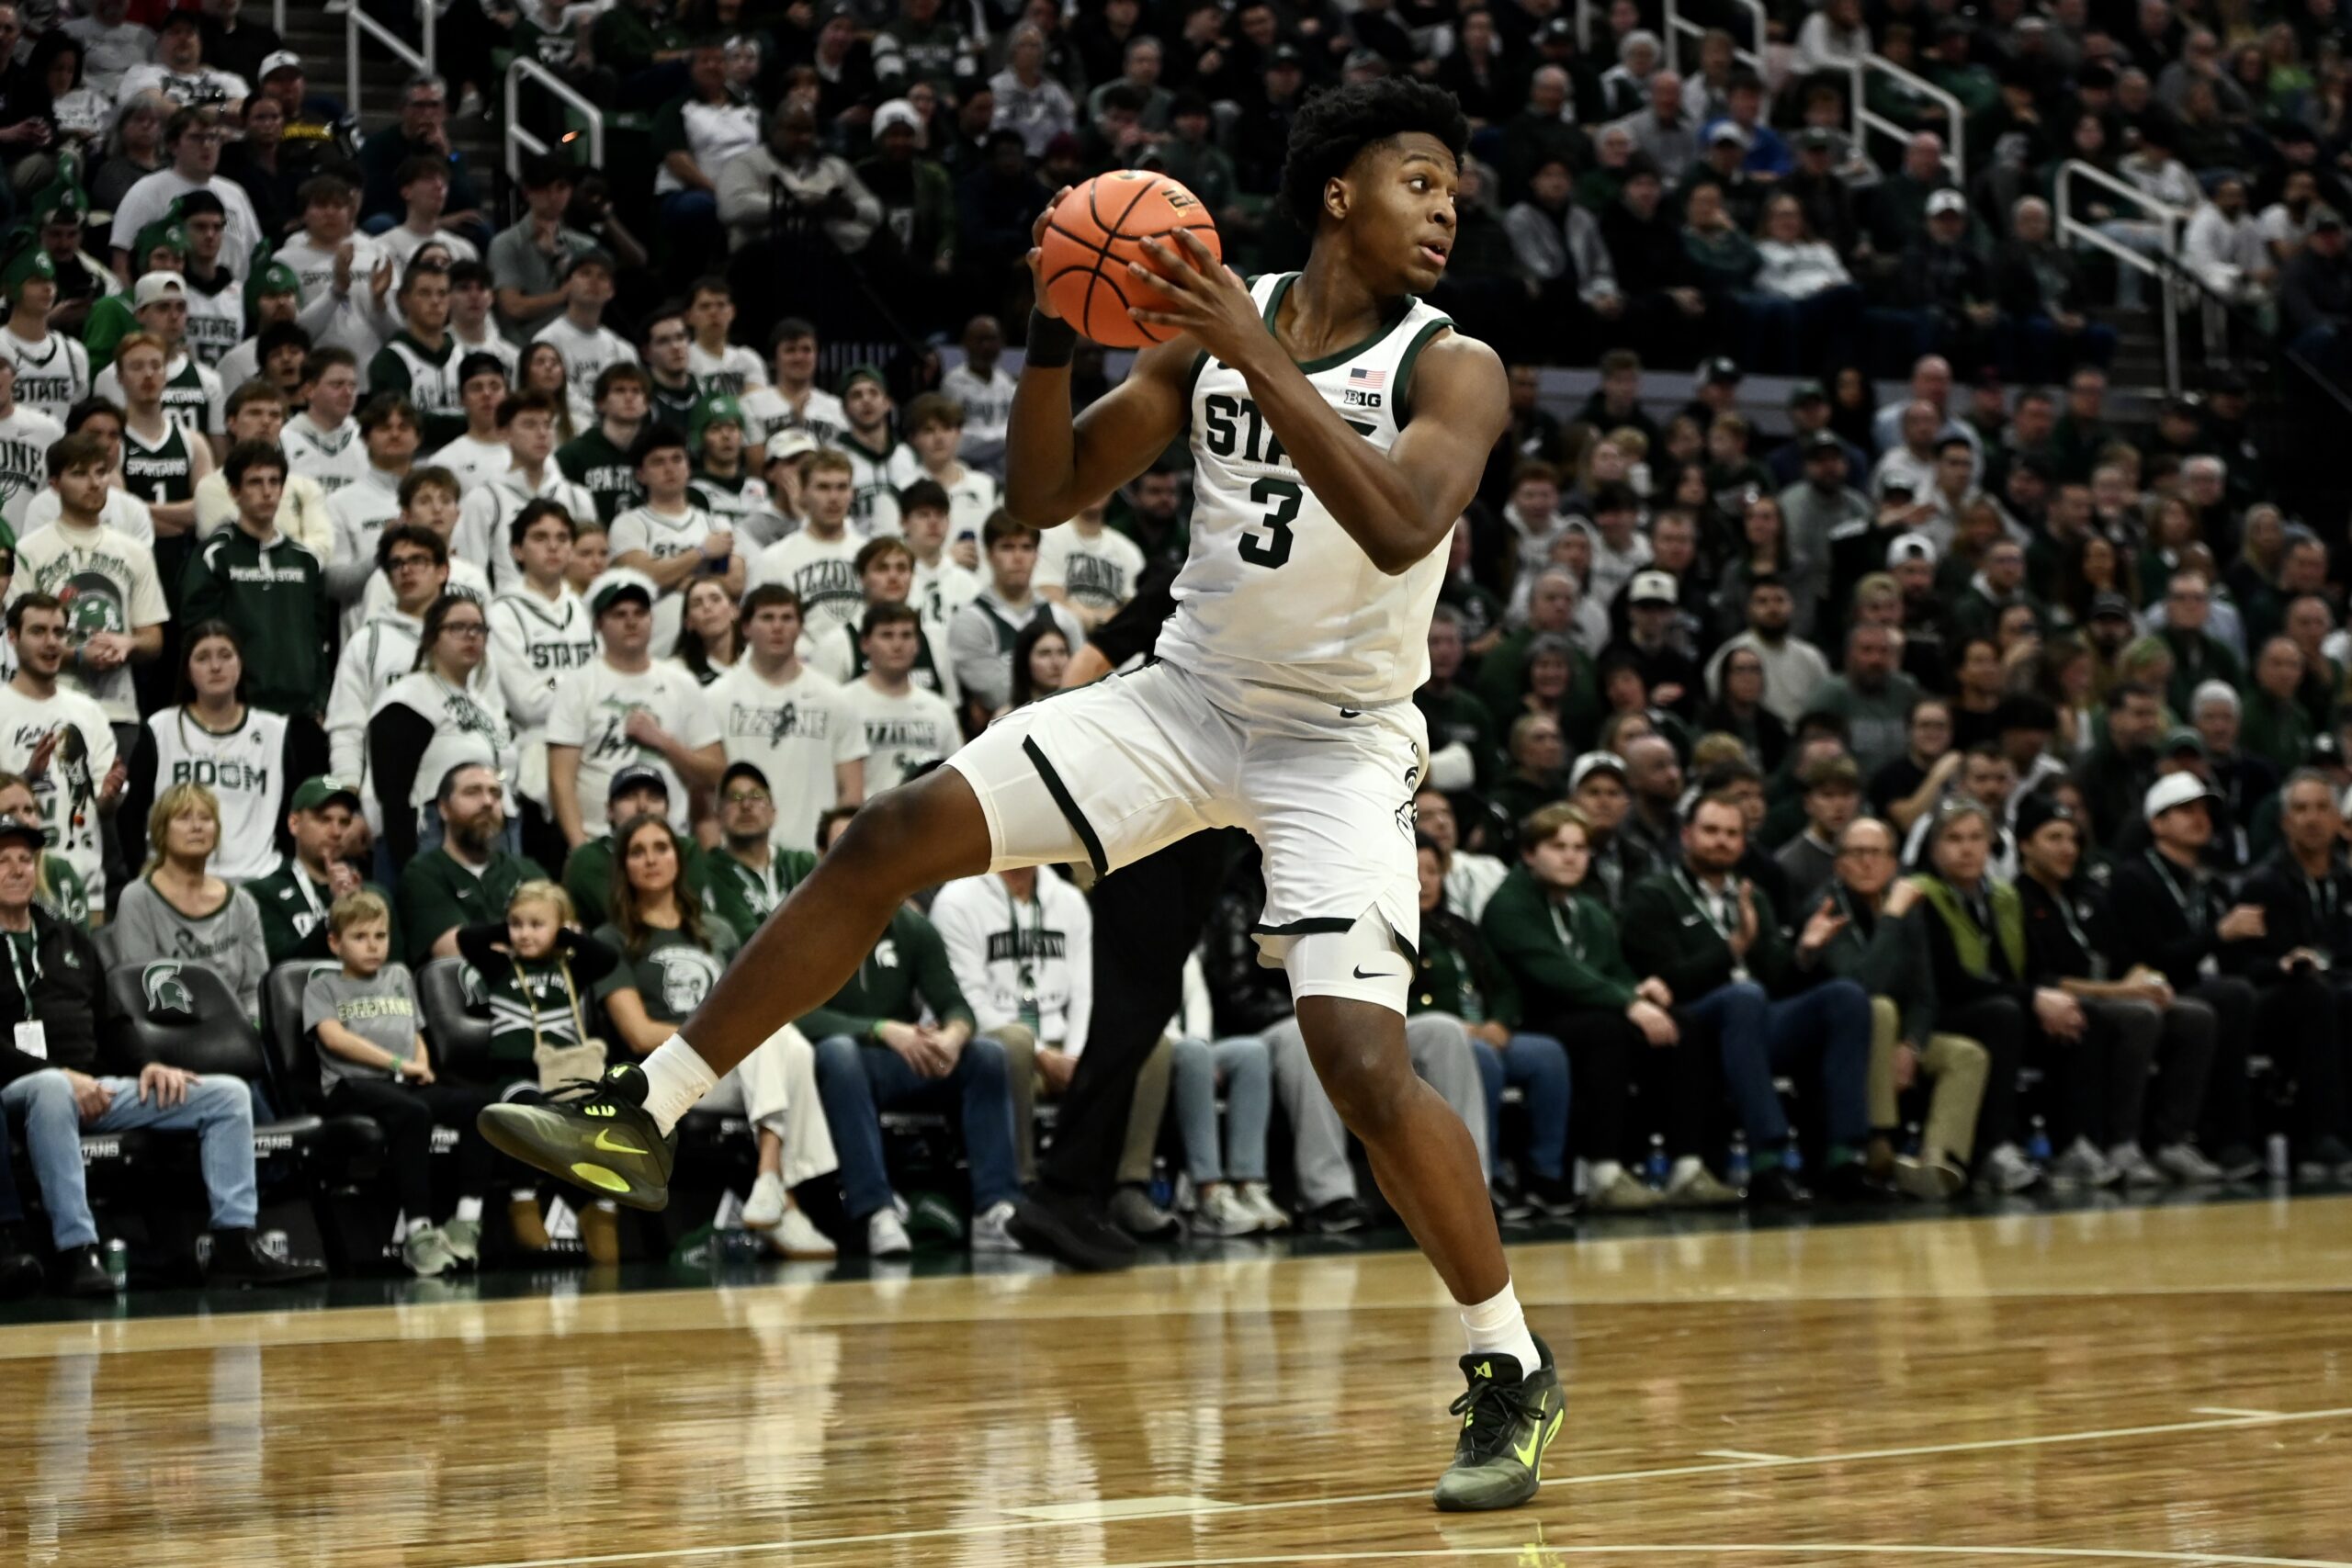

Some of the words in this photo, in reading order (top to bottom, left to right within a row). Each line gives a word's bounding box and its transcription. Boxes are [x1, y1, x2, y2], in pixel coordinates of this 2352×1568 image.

[187, 318, 237, 340] STATE
[12, 378, 71, 402] STATE
[126, 459, 187, 477] SPARTANS
[152, 481, 167, 504] 1
[1238, 477, 1303, 570] 3
[277, 566, 306, 582] STATE
[533, 643, 591, 668] STATE
